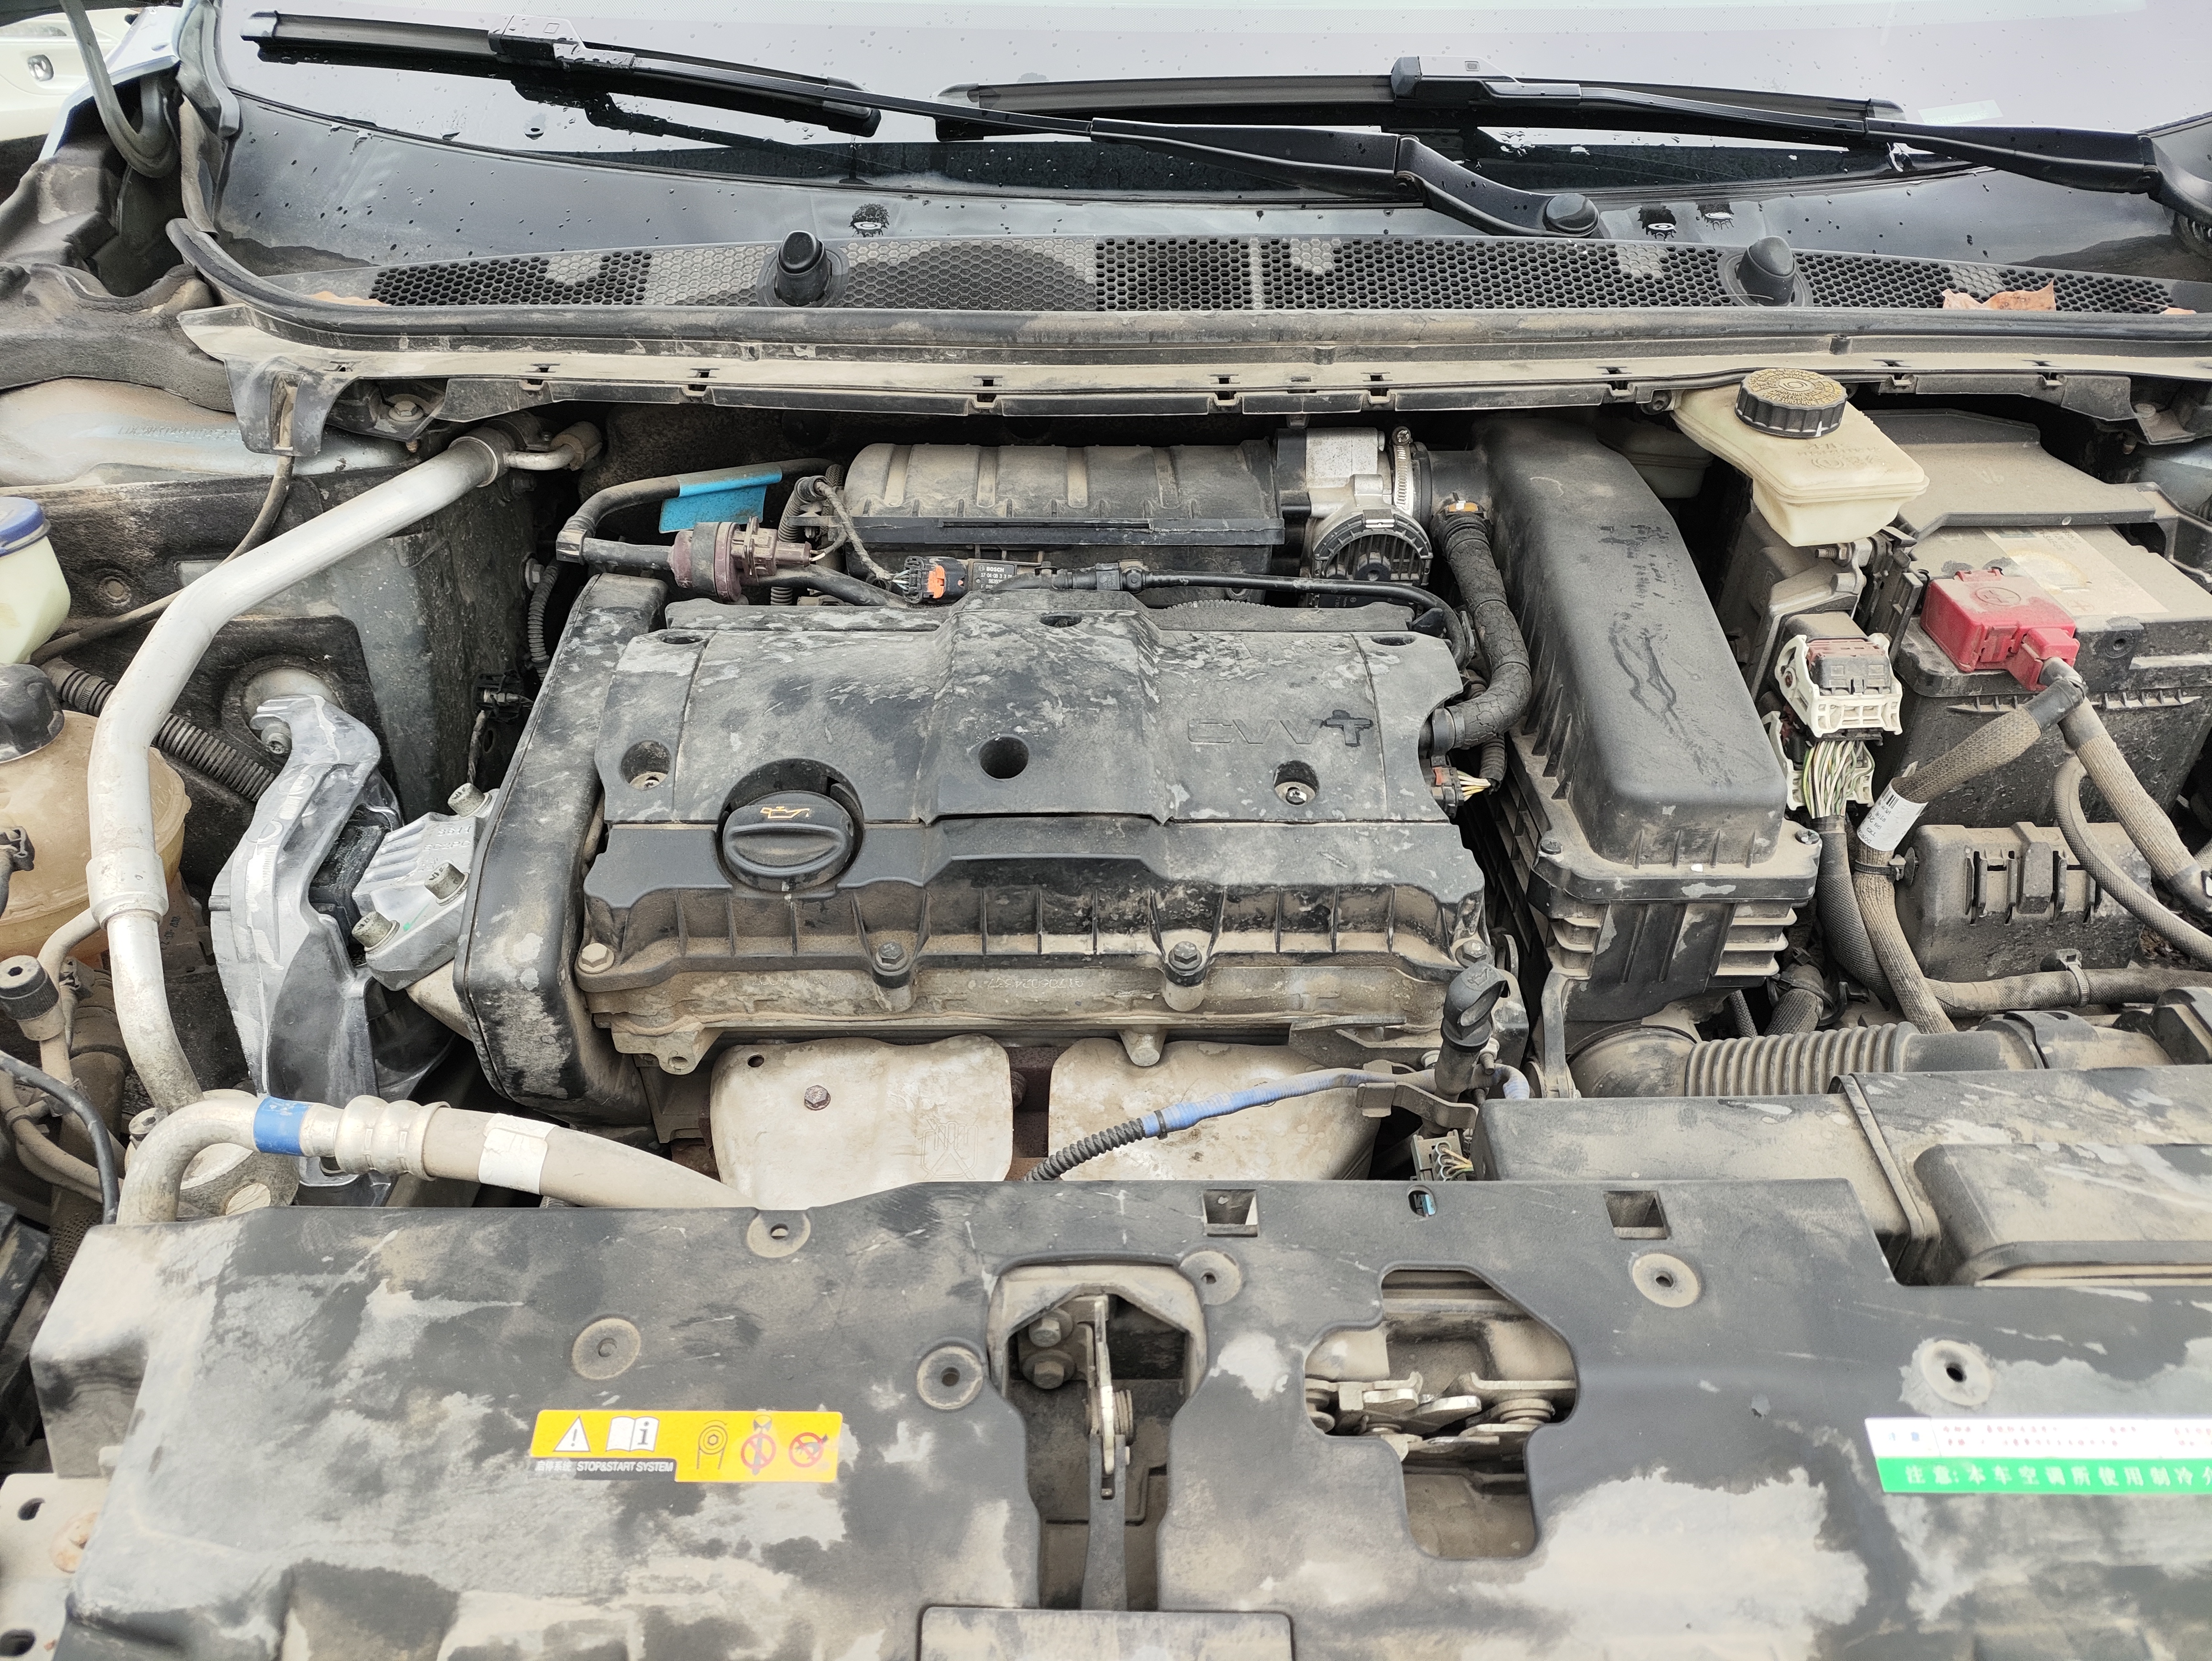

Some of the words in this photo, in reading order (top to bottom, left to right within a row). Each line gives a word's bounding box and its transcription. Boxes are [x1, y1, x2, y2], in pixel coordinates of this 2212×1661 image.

[1777, 397, 1797, 405] FLUID
[534, 1461, 572, 1472] 启停系统
[576, 1461, 636, 1472] STOP&START
[635, 1462, 674, 1472] SYSTEM
